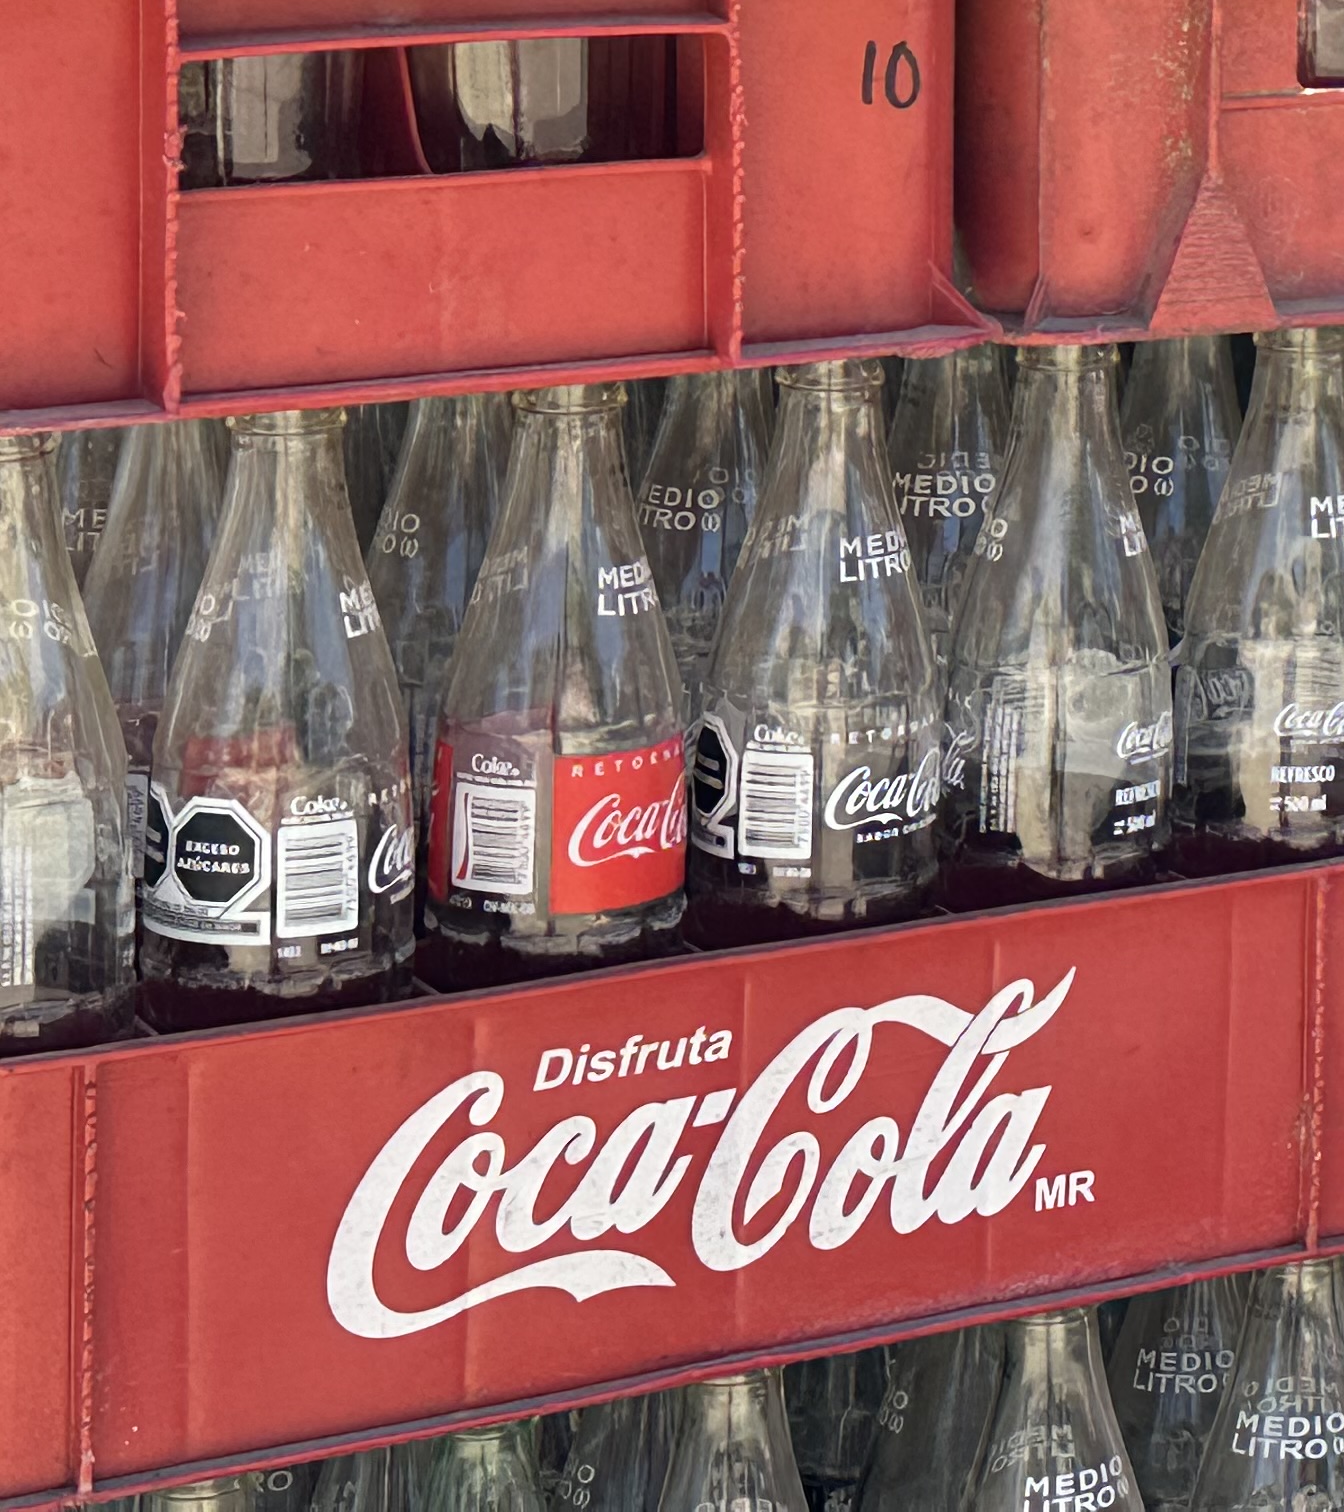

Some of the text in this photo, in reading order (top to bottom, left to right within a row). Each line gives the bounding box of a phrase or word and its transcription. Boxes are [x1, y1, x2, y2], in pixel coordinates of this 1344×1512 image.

[860, 39, 922, 111] 10
[533, 1025, 735, 1093] Disfruta
[325, 965, 1077, 1341] Coca-Cola
[1033, 1169, 1097, 1214] MR
[1132, 1369, 1218, 1395] LITRO
[1135, 1347, 1236, 1373] MEDIO
[1230, 1431, 1327, 1461] LITRO
[1024, 1453, 1124, 1498] MEDIO
